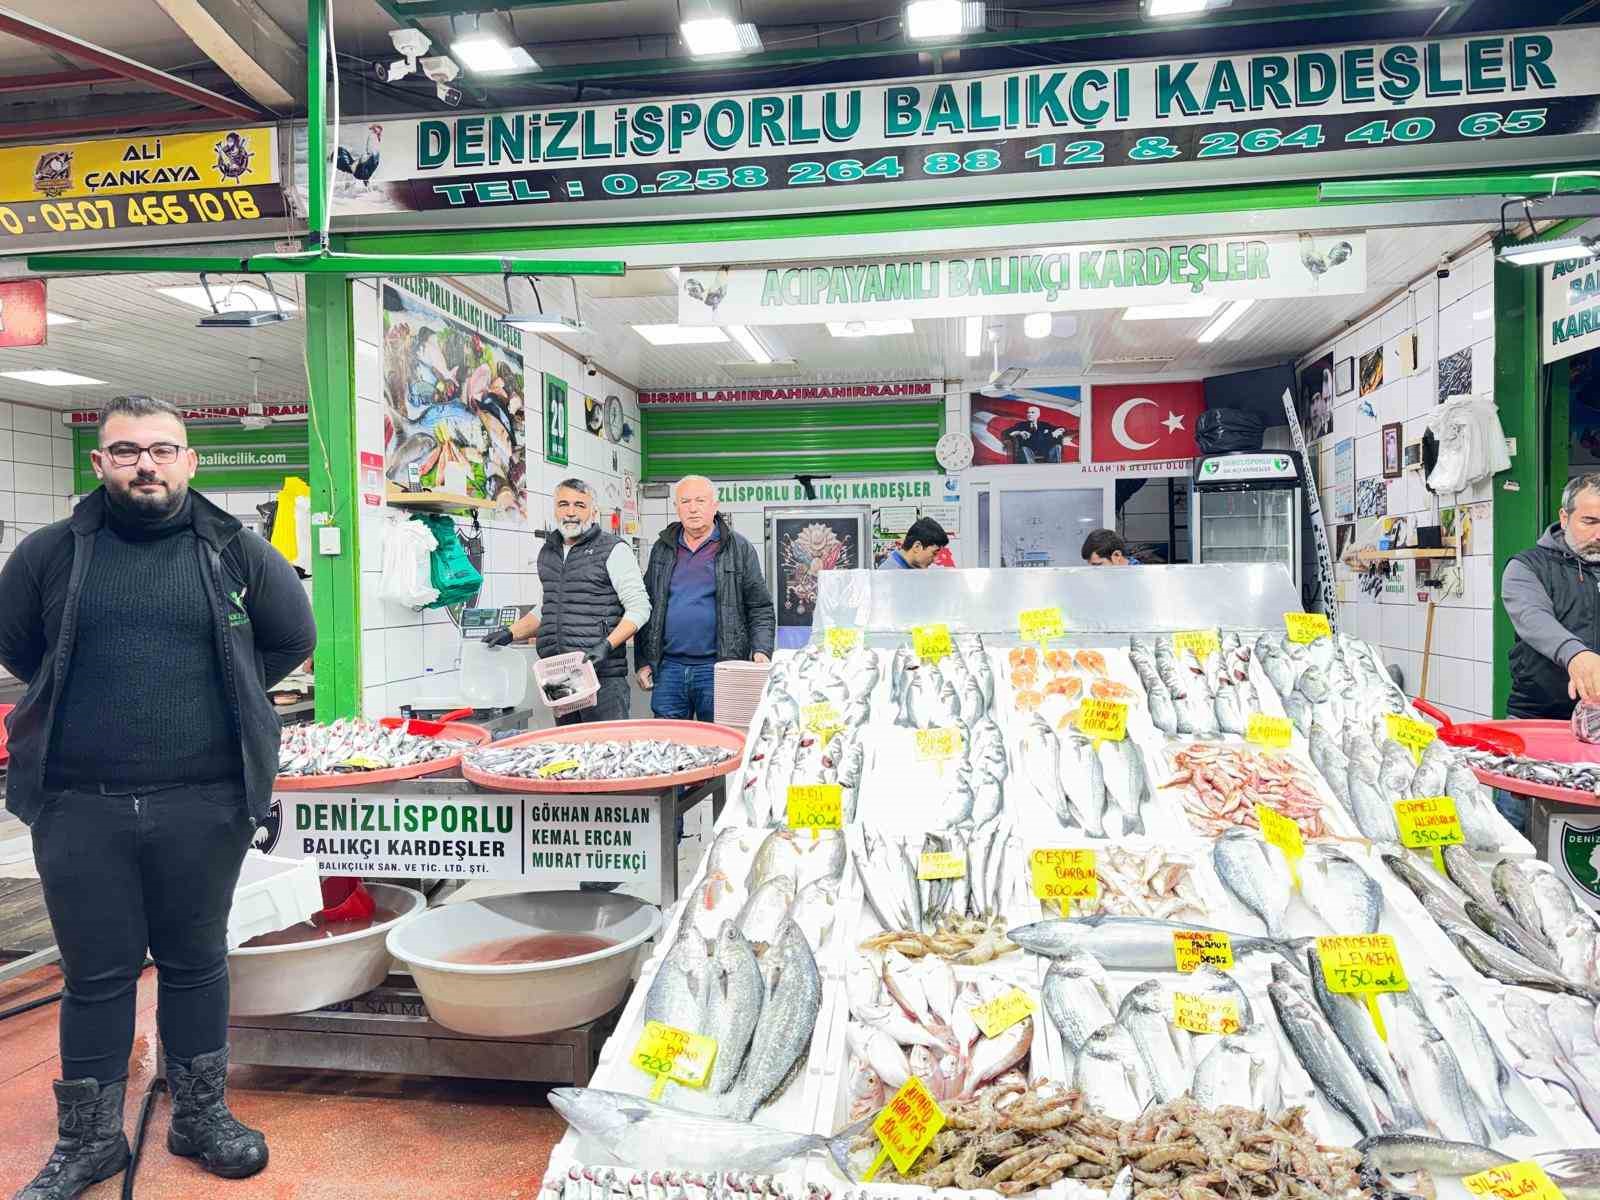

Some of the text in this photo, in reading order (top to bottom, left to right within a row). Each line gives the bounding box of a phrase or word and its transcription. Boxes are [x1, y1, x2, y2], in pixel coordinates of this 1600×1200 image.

[884, 68, 1130, 138] BALIKÇI
[1156, 35, 1557, 118] KARDEŞLER
[121, 139, 161, 162] ALİ
[433, 179, 549, 206] TEL
[602, 166, 767, 196] 0.258
[788, 154, 904, 184] 264
[923, 149, 1001, 176] 88
[1025, 141, 1105, 167] 12
[1128, 136, 1183, 161] &
[1197, 123, 1326, 159] 264
[1345, 115, 1436, 144] 40
[1457, 108, 1548, 138] 65
[84, 165, 201, 192] ÇANKAYA
[40, 199, 117, 232] 0507
[128, 193, 189, 226] 466
[948, 252, 1071, 302] BALIKÇI
[1079, 240, 1272, 293] KARDEŞLER
[852, 481, 932, 502] KARDEŞLER
[295, 797, 513, 834] DENİZLİSPORLU
[532, 802, 650, 824] GÖKHAN ARSLAN
[303, 837, 505, 861] BALIKÇI KARDEŞLER
[532, 829, 632, 847] KEMAL ERCAN
[405, 863, 417, 872] VE
[532, 849, 646, 875] MURAT TÜFEKÇİ
